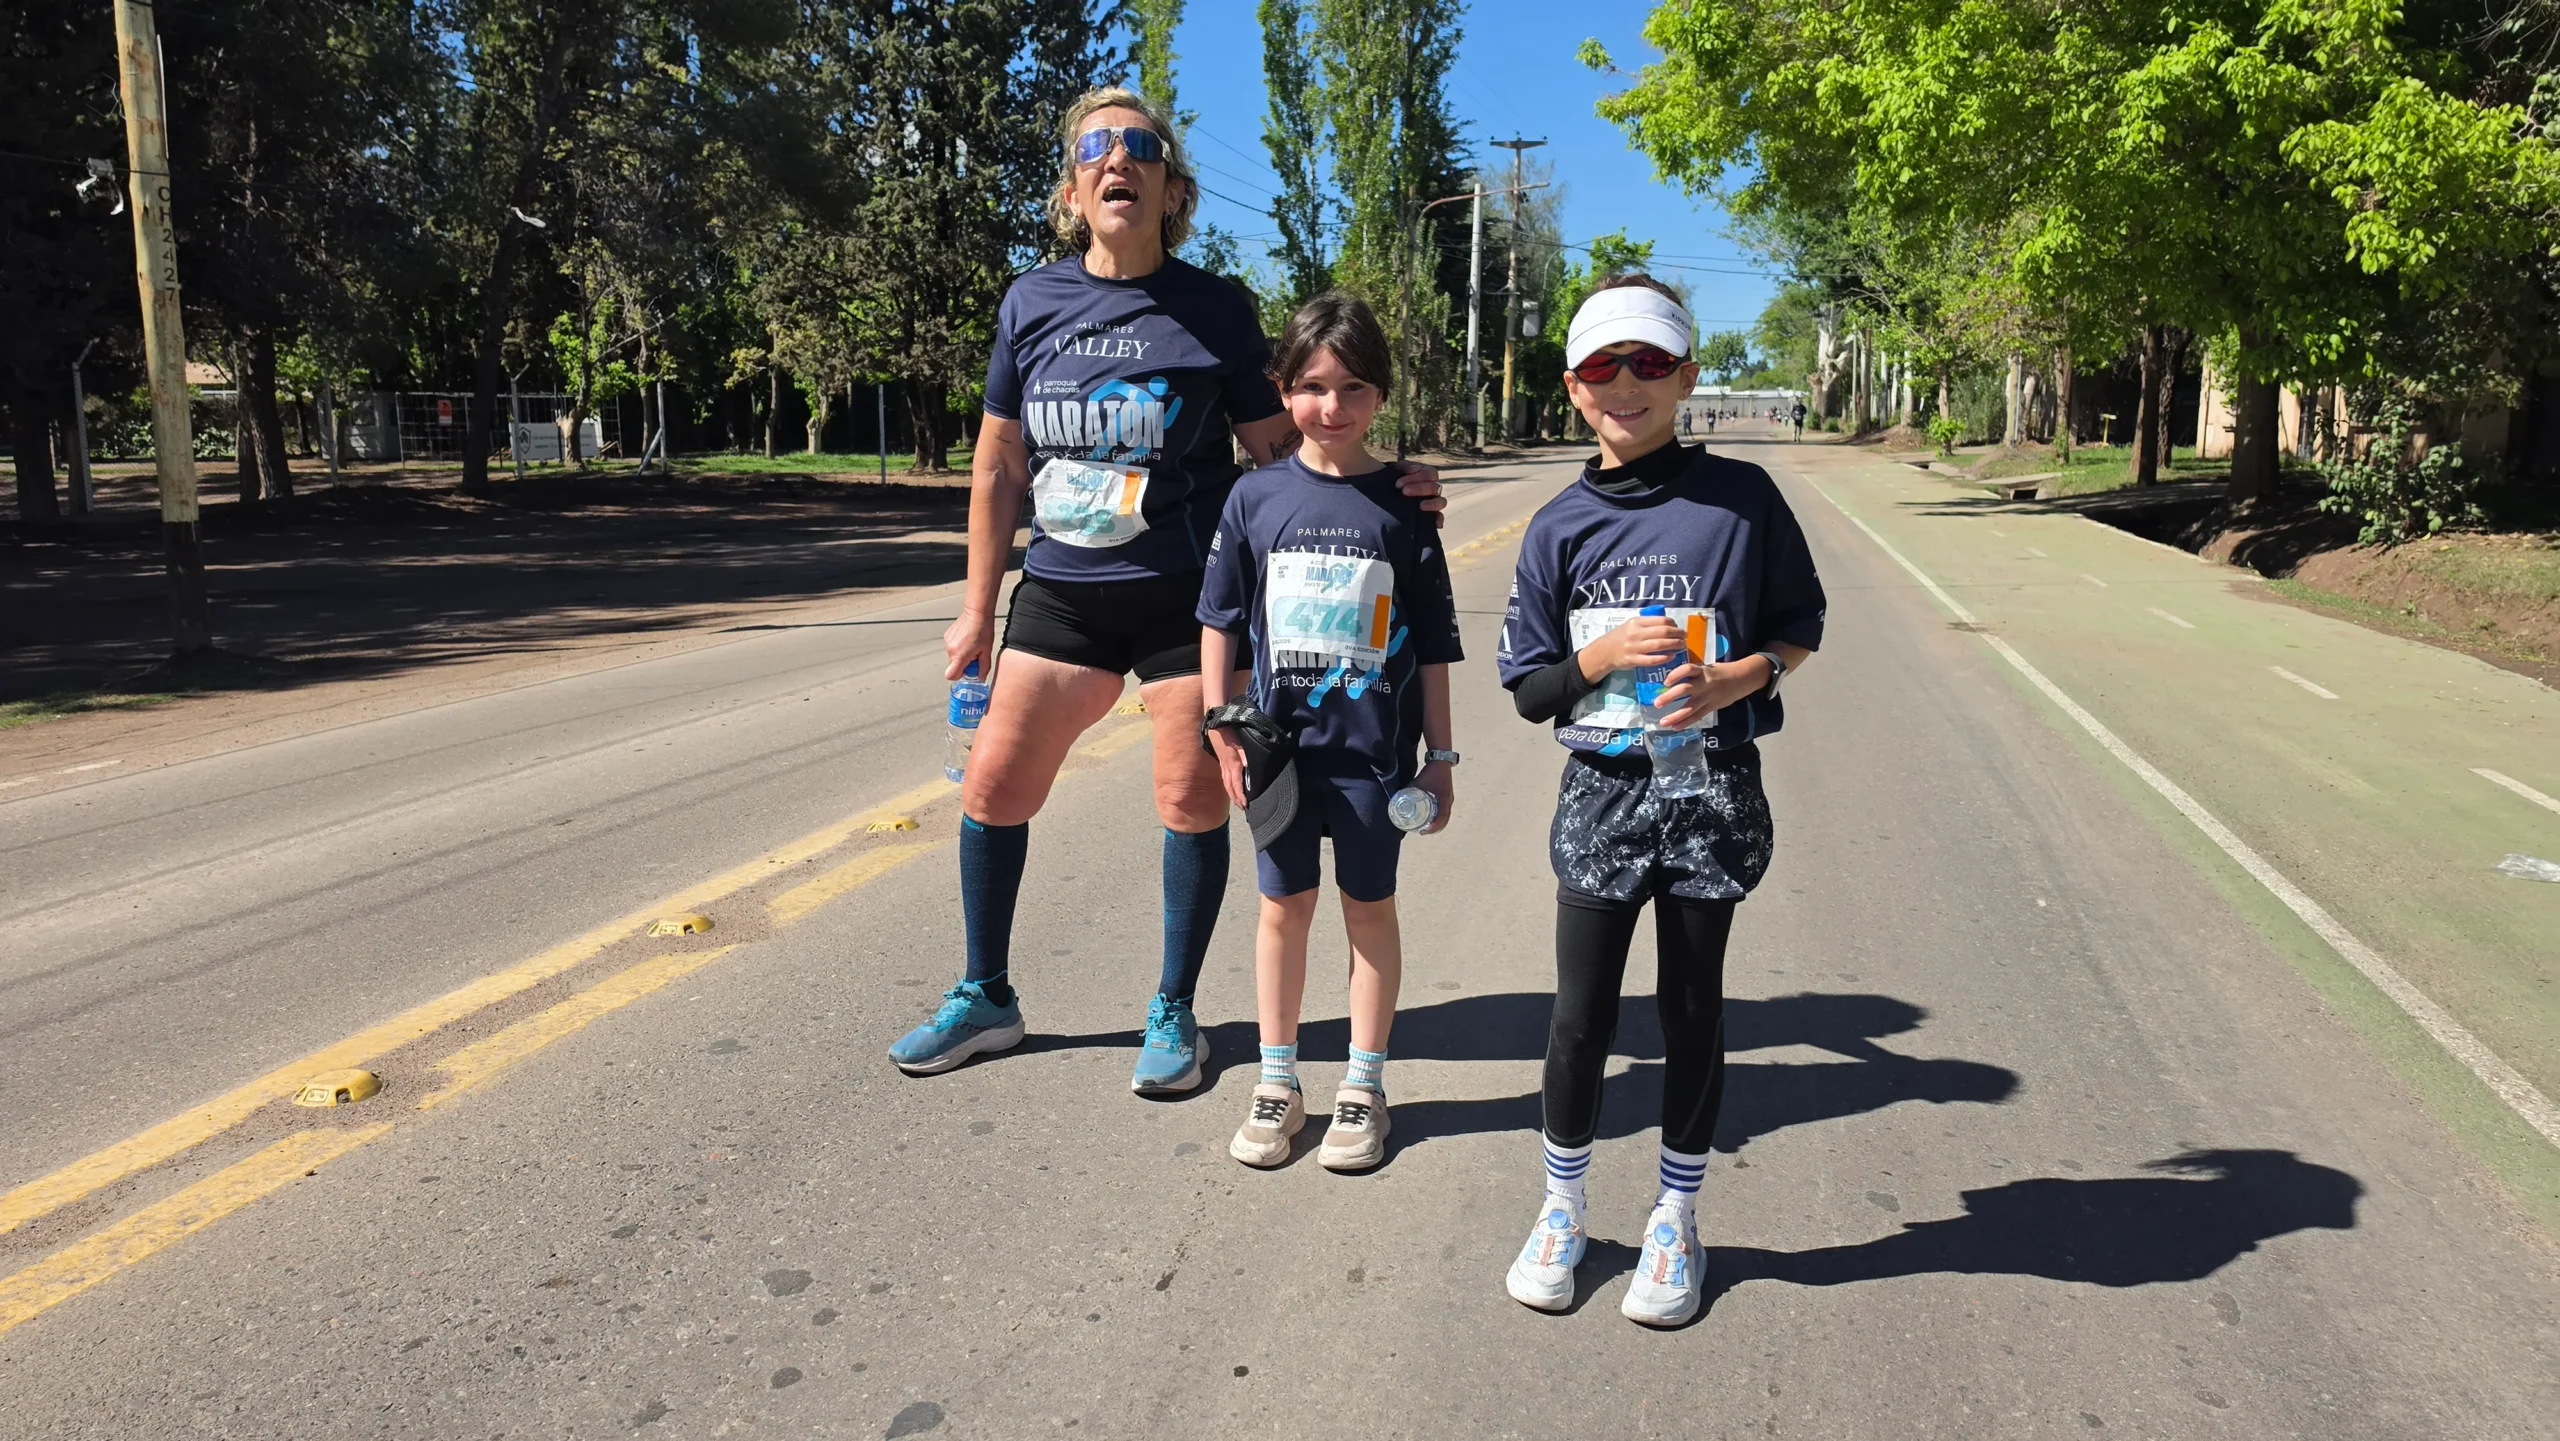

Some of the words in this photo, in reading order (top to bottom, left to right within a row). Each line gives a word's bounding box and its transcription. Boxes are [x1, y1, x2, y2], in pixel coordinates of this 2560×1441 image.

[157, 186, 176, 302] CH2427
[1055, 333, 1151, 360] VALLEY
[1042, 386, 1051, 394] de
[1052, 385, 1080, 394] chacras
[1043, 379, 1077, 387] parroquia
[1027, 389, 1165, 448] MARATÓN
[1096, 449, 1110, 460] la
[1111, 449, 1162, 464] familia
[1297, 528, 1361, 539] PALMARES
[1600, 554, 1678, 571] PALMARES
[1578, 574, 1702, 607] VALLEY
[1285, 602, 1363, 638] 474
[1291, 673, 1325, 687] toda
[1328, 674, 1341, 687] la
[1558, 727, 1587, 742] para
[1587, 728, 1620, 745] toda
[1628, 729, 1644, 747] la
